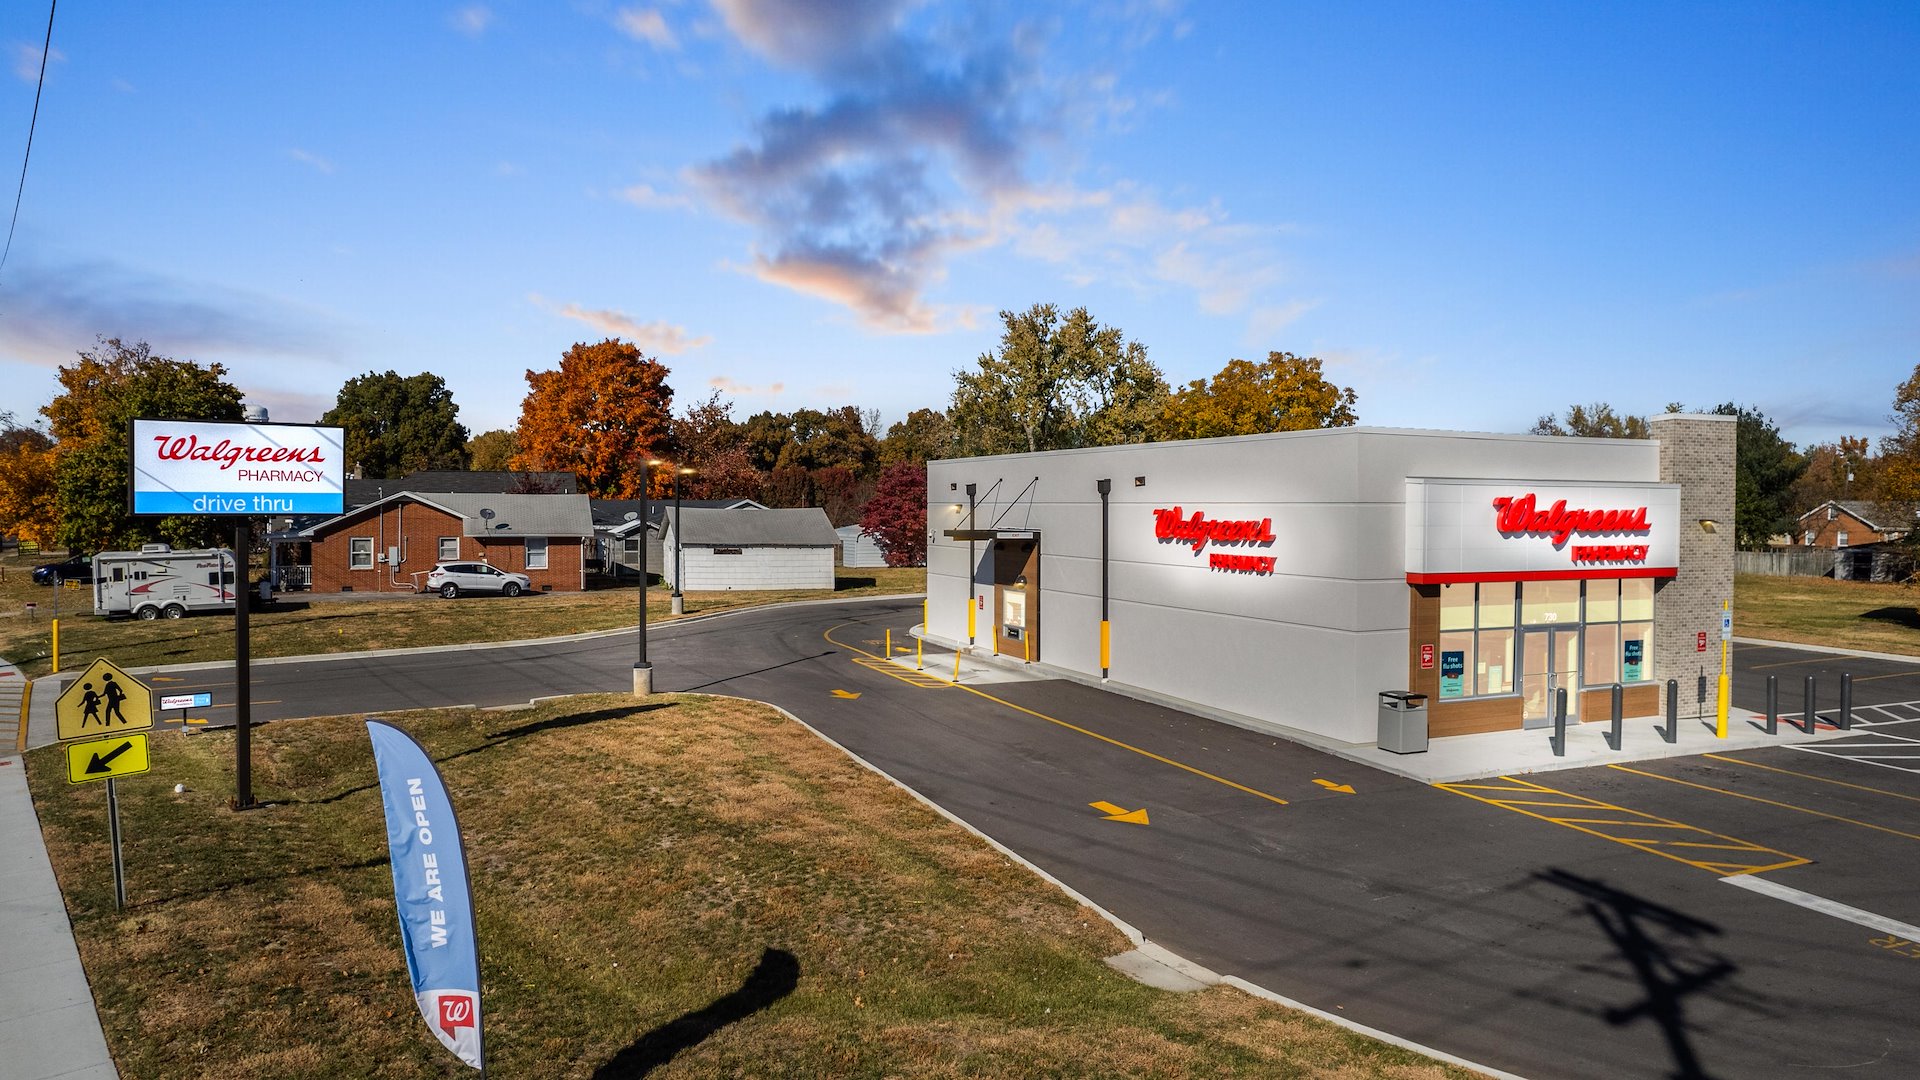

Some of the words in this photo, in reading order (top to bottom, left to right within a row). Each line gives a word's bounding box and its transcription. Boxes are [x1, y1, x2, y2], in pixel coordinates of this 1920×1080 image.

[153, 434, 326, 470] Walgreens
[238, 469, 324, 483] PHARMACY
[192, 494, 246, 512] drive
[253, 494, 293, 512] thru
[1492, 492, 1652, 545] Walgreens
[1153, 506, 1277, 551] Walgreens
[1210, 553, 1278, 573] PHARMACY
[1571, 545, 1650, 562] PHARMACY
[407, 778, 433, 846] OPEN
[423, 853, 444, 902] ARE
[431, 910, 448, 949] WE
